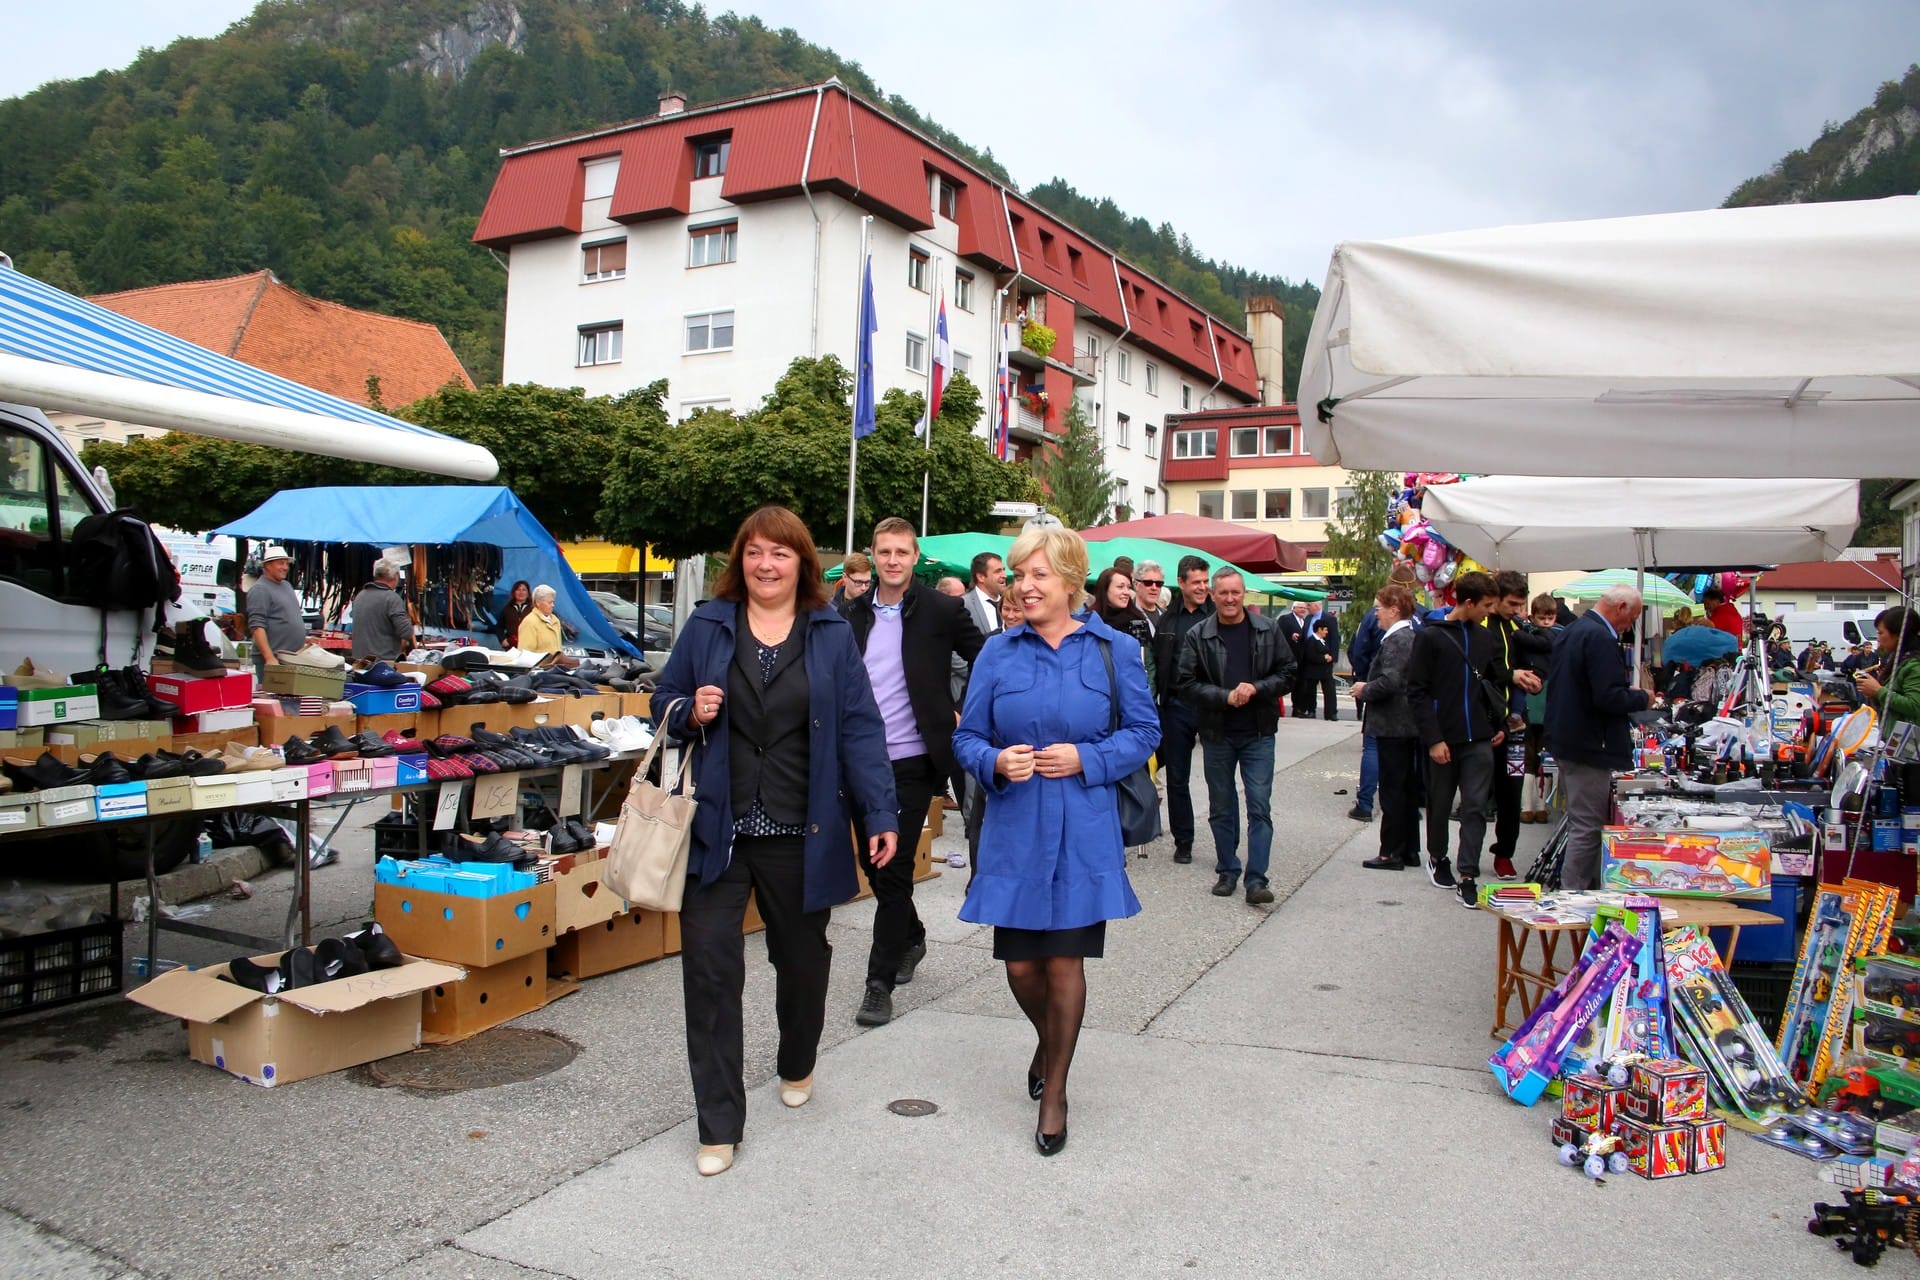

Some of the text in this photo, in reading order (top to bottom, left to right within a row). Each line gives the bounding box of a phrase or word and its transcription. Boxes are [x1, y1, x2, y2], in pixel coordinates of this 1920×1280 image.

[188, 563, 214, 574] SATLER
[398, 696, 416, 704] Comfort
[1790, 847, 1811, 855] GLASSES
[1786, 957, 1809, 1020] TRUCK
[1575, 993, 1604, 1030] Guitar
